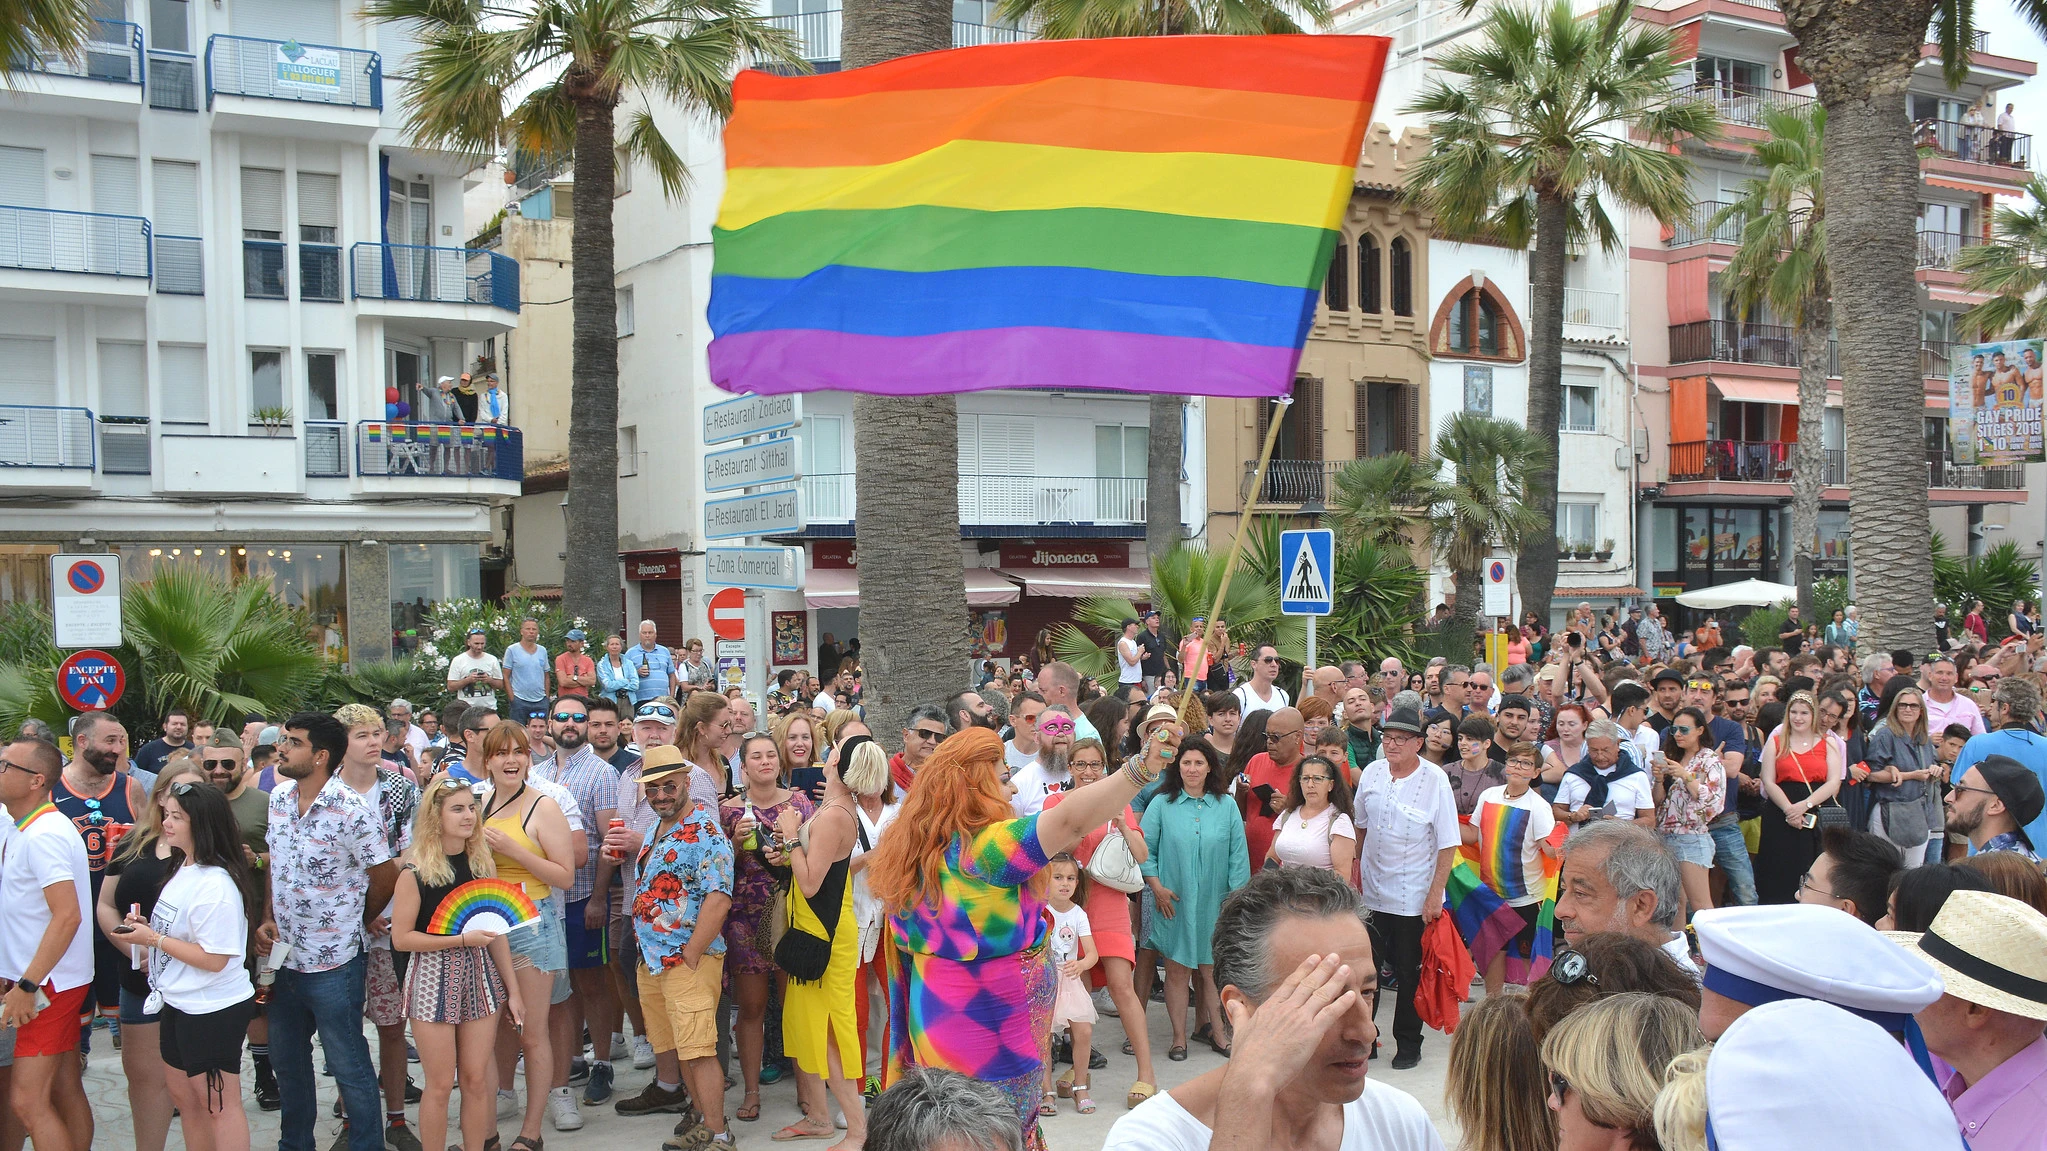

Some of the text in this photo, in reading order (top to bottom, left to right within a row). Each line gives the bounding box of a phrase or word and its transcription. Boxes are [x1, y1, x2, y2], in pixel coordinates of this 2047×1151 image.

[311, 56, 338, 67] LACLAU
[2002, 389, 2015, 401] 10
[714, 396, 792, 430] Restaurant Zodiaco
[1977, 407, 2041, 424] GAY PRIDE
[1977, 421, 2042, 438] SITGES 2019
[715, 446, 788, 478] Restaurant Sitthai
[715, 503, 757, 526] Restaurant
[760, 500, 769, 520] El
[716, 554, 779, 576] Zona Comercial
[1031, 550, 1099, 566] Jijonenca
[1685, 562, 1707, 570] infusions
[637, 562, 667, 576] Jijonenca
[68, 665, 117, 675] EXCEPTE
[78, 675, 104, 685] TAXI
[87, 831, 101, 851] 6
